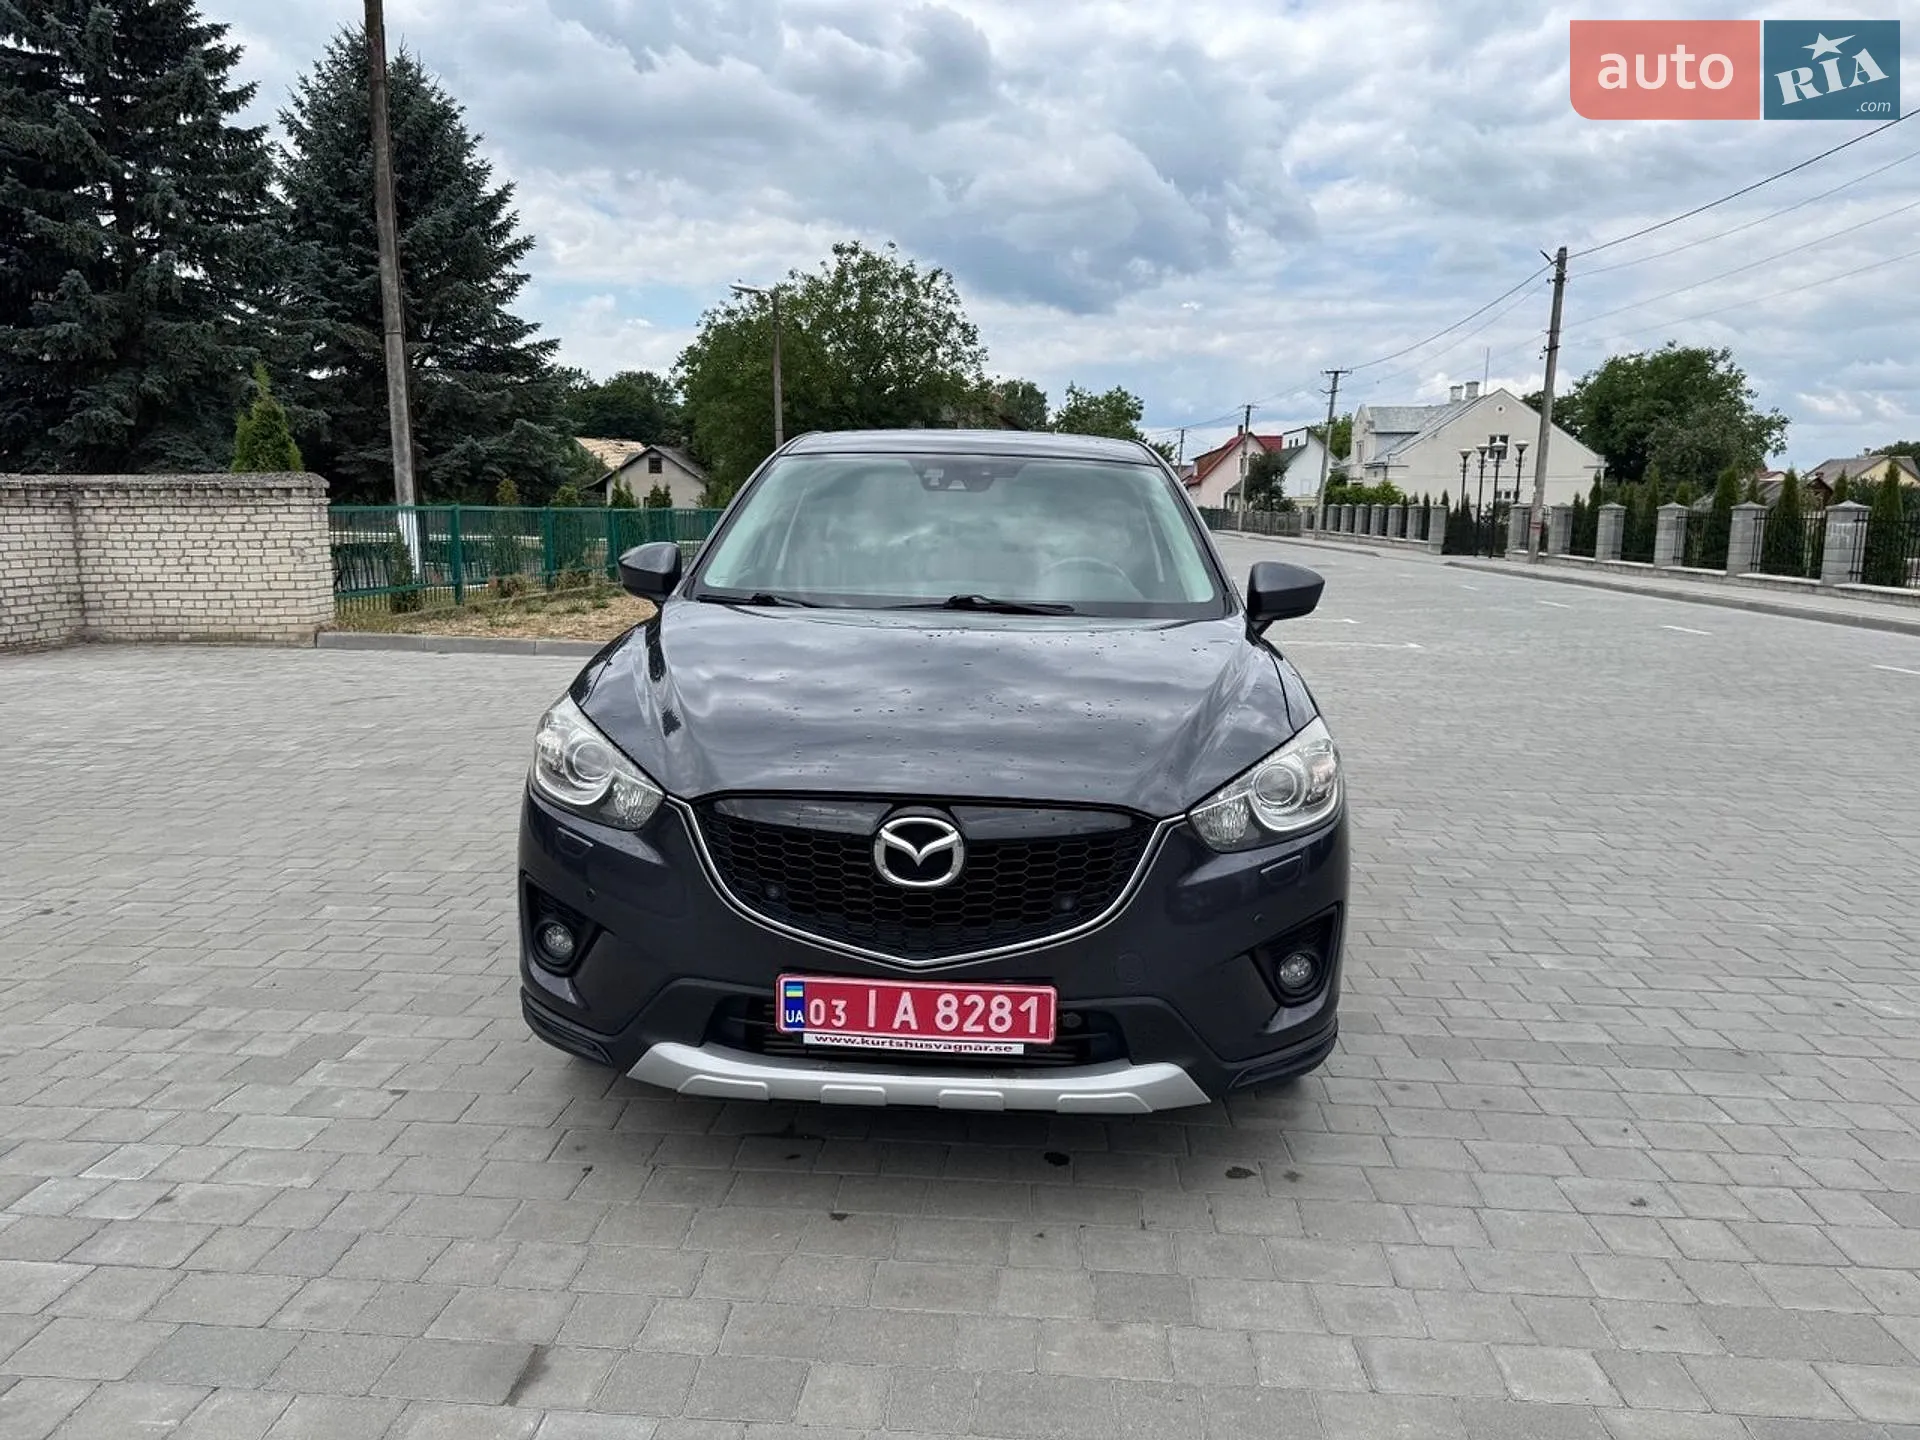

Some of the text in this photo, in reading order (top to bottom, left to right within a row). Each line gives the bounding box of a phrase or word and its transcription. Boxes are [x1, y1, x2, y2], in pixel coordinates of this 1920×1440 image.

[785, 1009, 805, 1024] UA
[809, 998, 847, 1027] 03
[934, 993, 1038, 1034] 8281
[814, 1034, 1013, 1053] www.kurtshusvagnar.se
